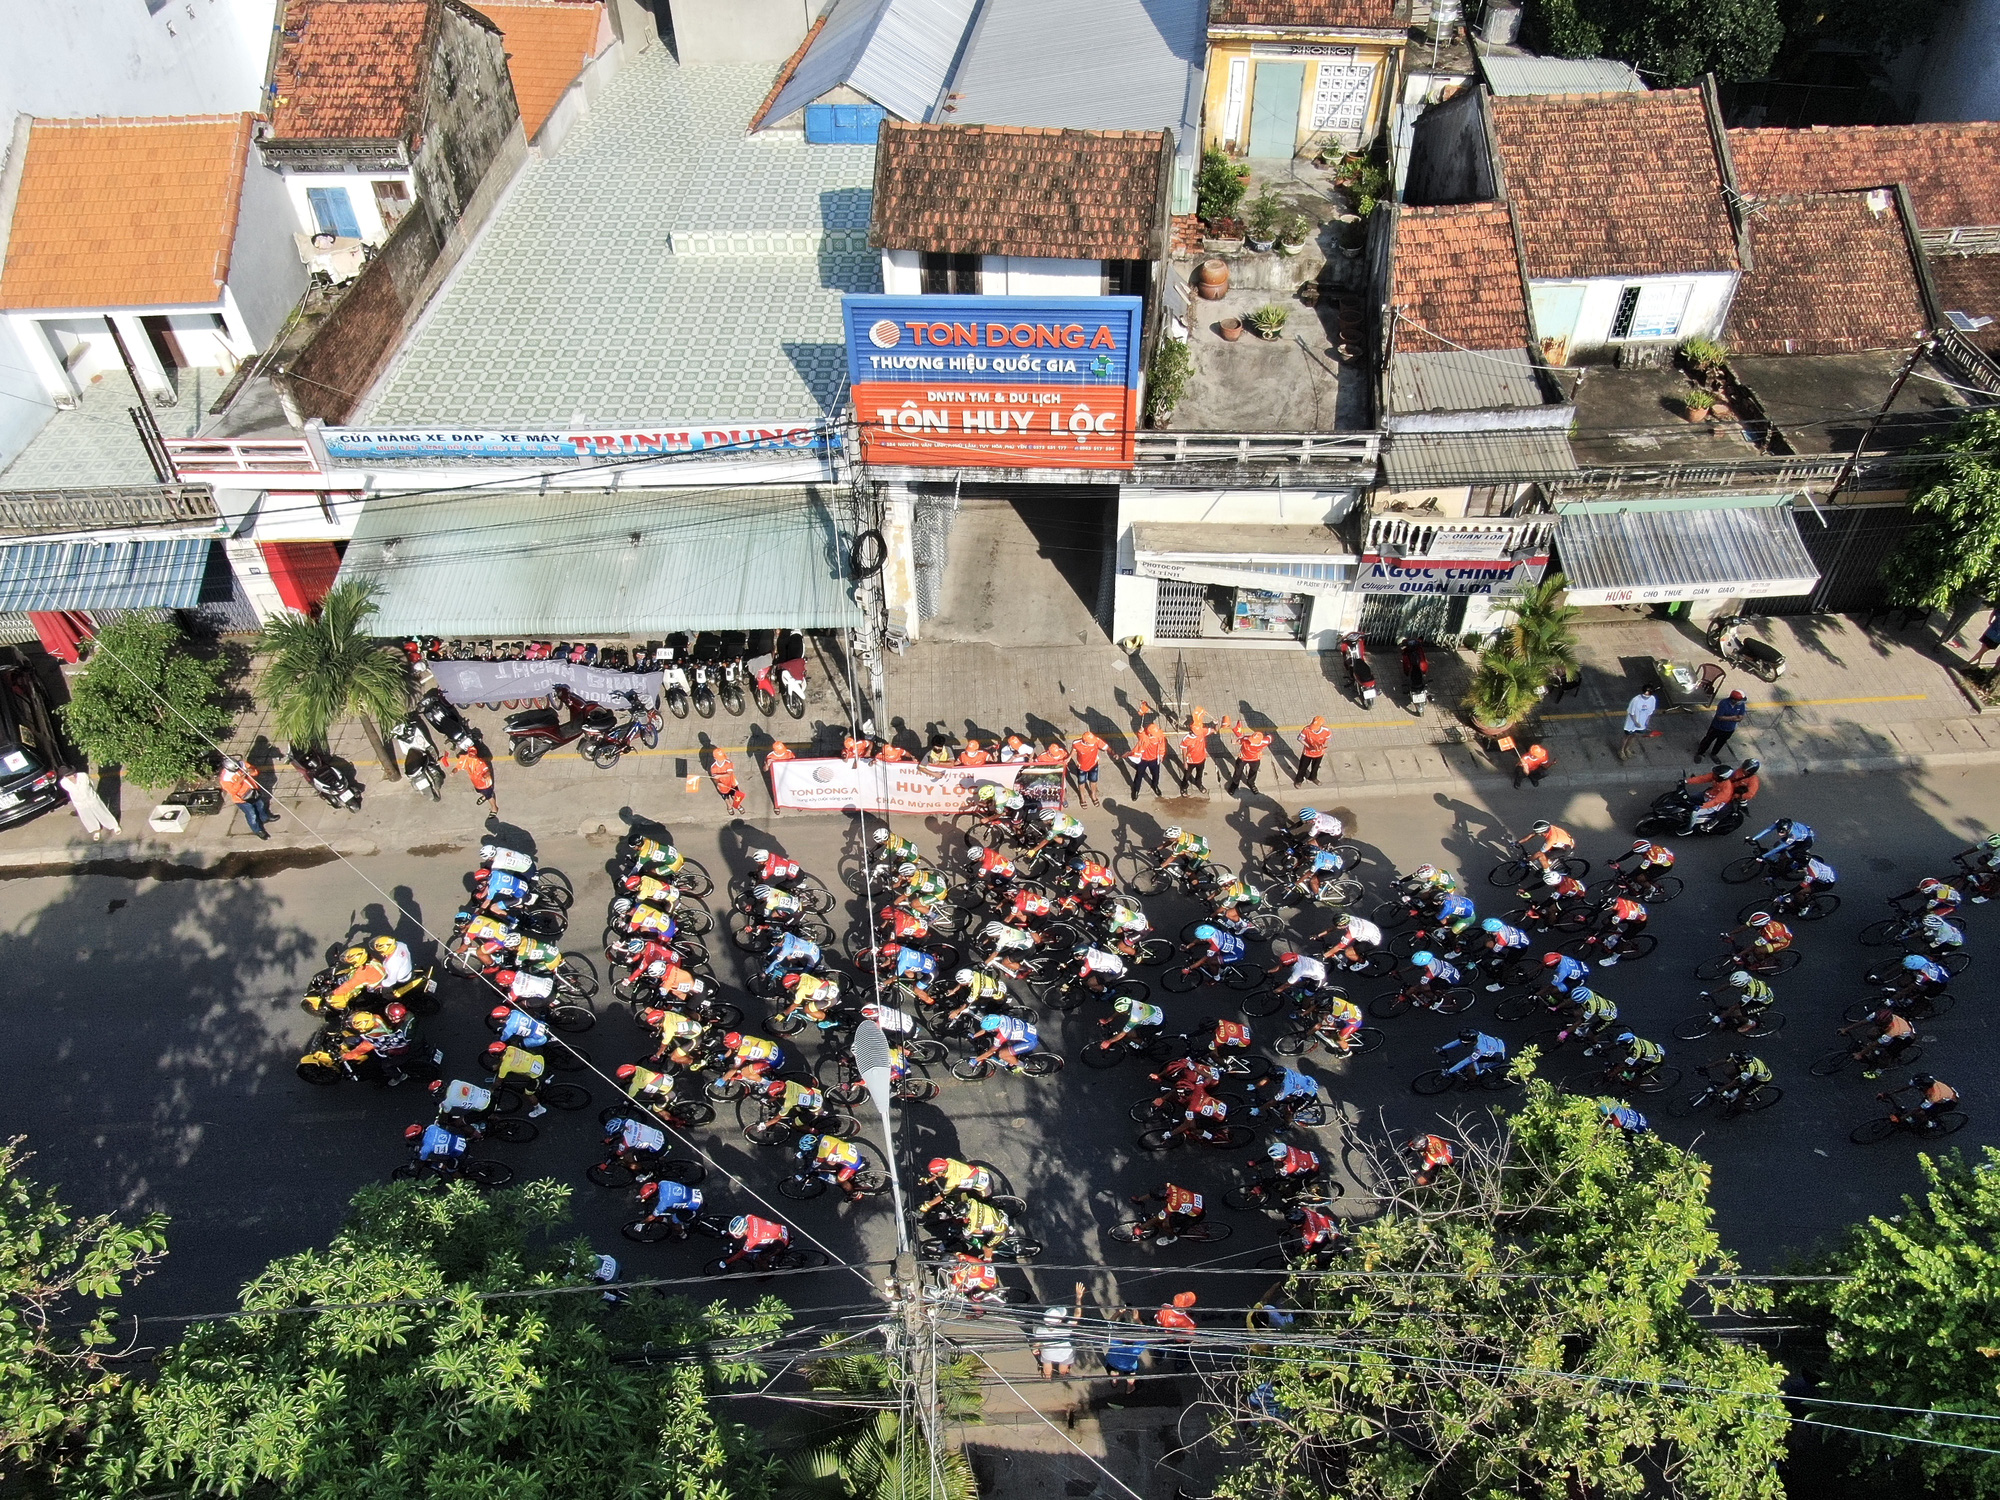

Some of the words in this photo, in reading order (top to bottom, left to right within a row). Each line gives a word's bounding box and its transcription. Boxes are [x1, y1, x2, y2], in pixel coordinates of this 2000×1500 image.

[905, 321, 978, 347] TON
[986, 323, 1085, 349] DONG
[1089, 325, 1117, 350] A
[870, 355, 944, 370] THƯƠNG
[949, 353, 988, 375] HIỆU
[992, 353, 1042, 374] QUỐC
[1046, 359, 1077, 373] GIA
[927, 391, 965, 403] DNTN
[969, 391, 991, 404] TM
[994, 392, 1006, 404] &
[1032, 392, 1061, 408] LỊCH
[877, 399, 950, 434] TÔN
[962, 410, 1035, 436] HUY
[1050, 402, 1117, 444] LỘC
[339, 432, 373, 443] CỬA
[377, 432, 422, 442] HÀNG
[426, 434, 447, 442] XE
[451, 434, 484, 443] ĐẠP
[501, 434, 520, 442] XE
[526, 433, 560, 443] MÁY
[1142, 561, 1186, 571] PHOTOCOPY
[1457, 582, 1492, 594] LOA
[1642, 590, 1658, 599] CHO
[789, 788, 814, 797] TON
[816, 787, 849, 795] DONG
[850, 787, 859, 795] A
[896, 781, 935, 796] HUY
